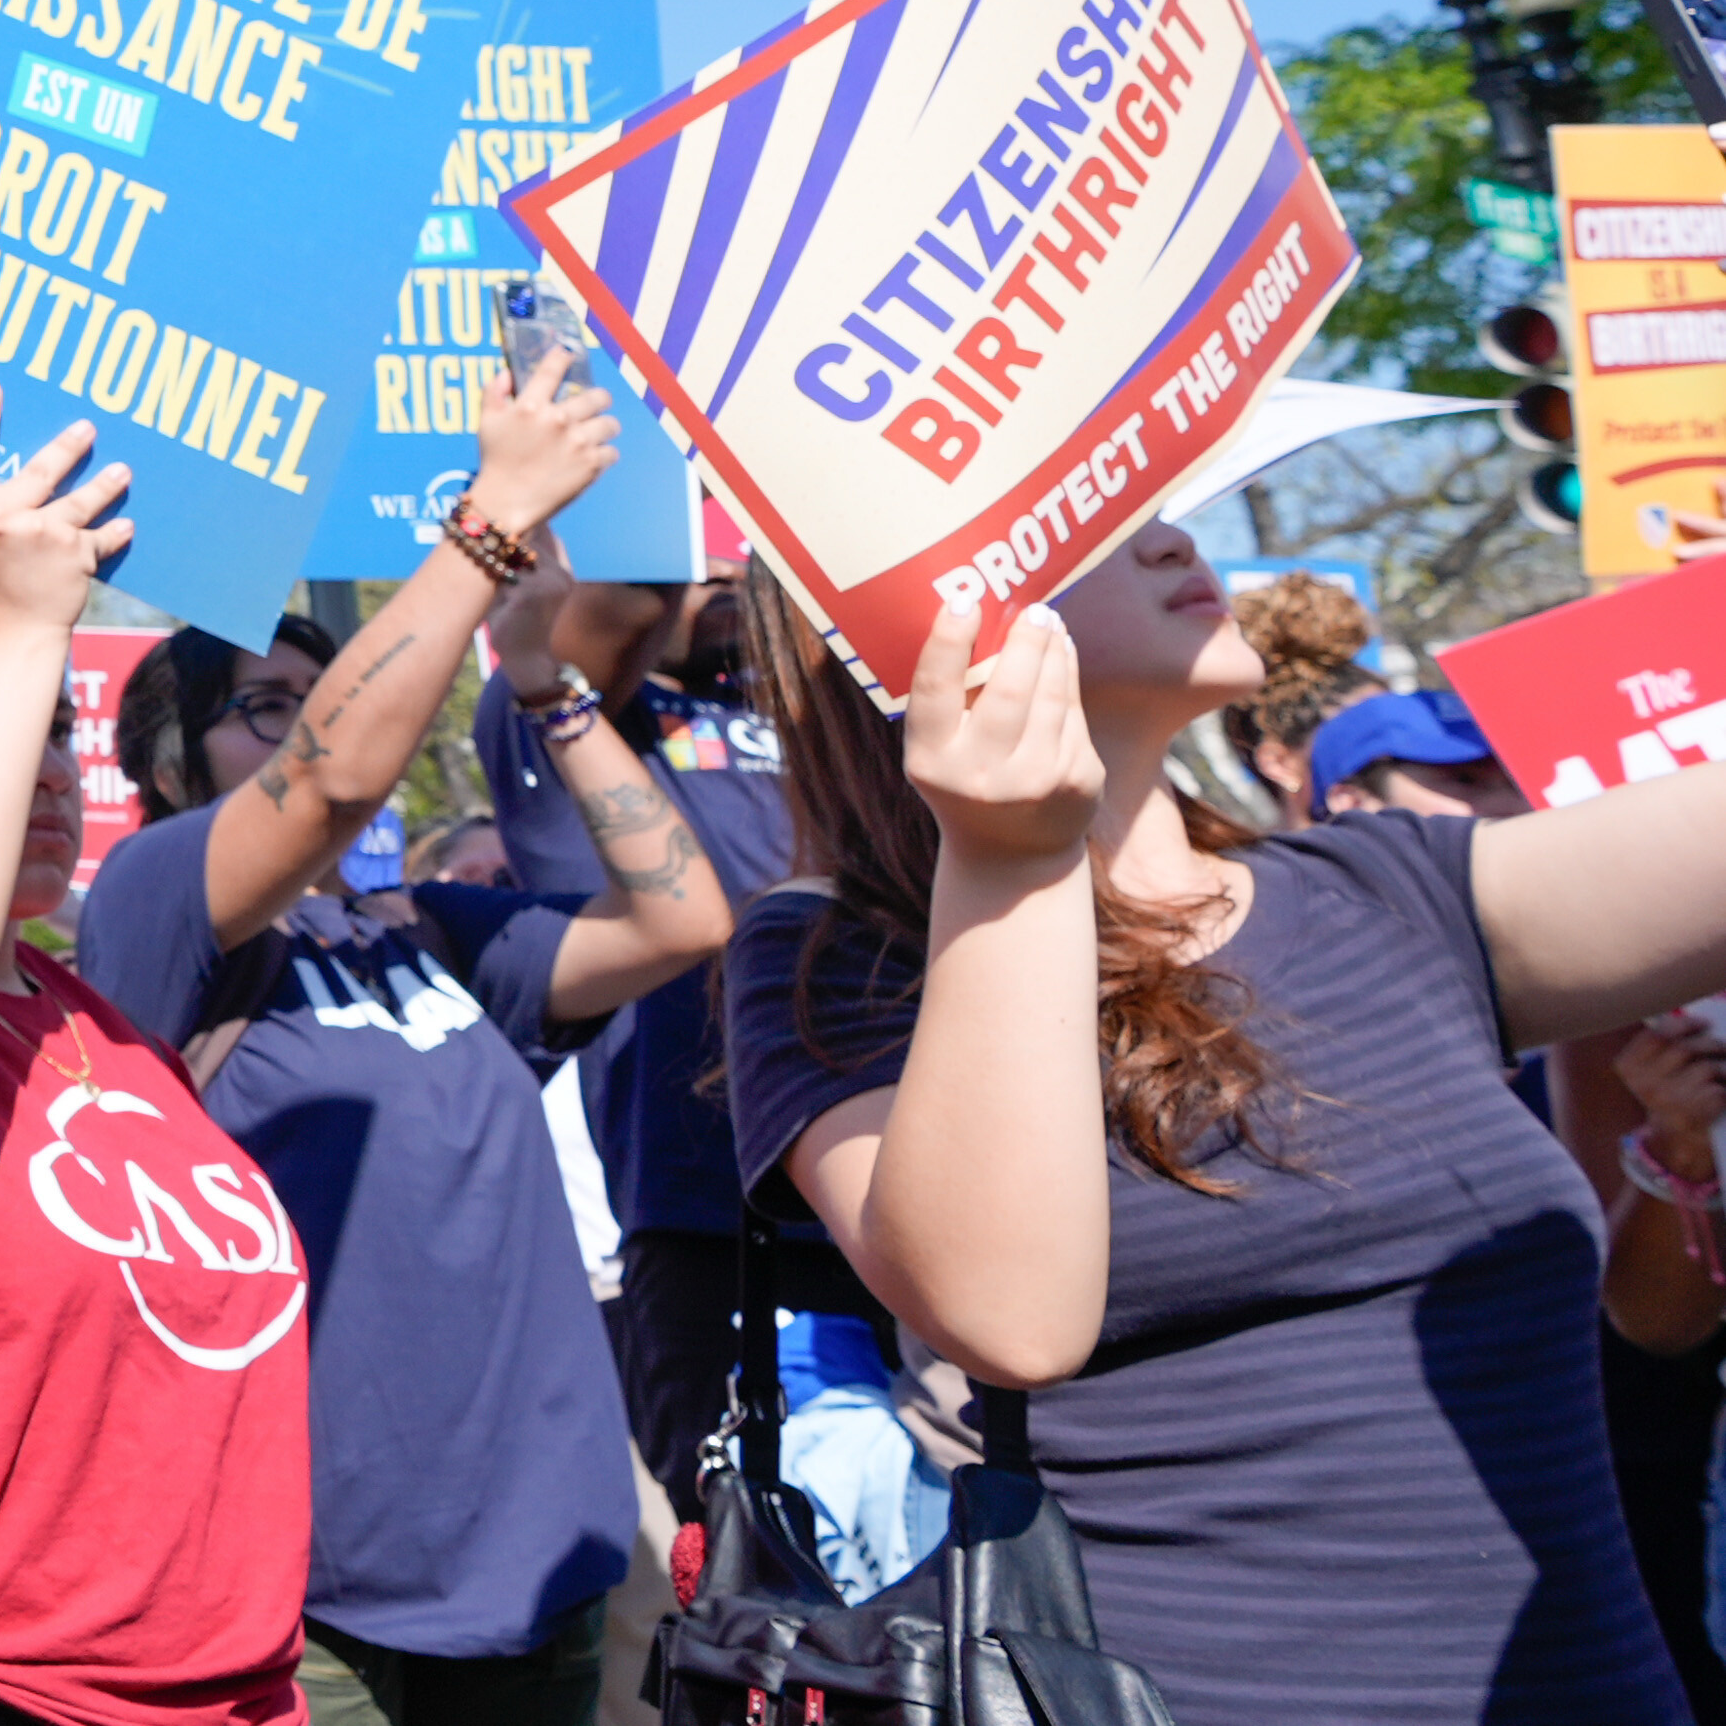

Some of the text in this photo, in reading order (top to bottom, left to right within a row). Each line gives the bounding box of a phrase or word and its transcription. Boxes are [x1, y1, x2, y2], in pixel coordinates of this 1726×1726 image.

[21, 62, 145, 142] EST UN
[374, 353, 500, 435] RIGH
[930, 221, 1315, 615] PROTECT THE RIGHT
[1616, 667, 1697, 719] The
